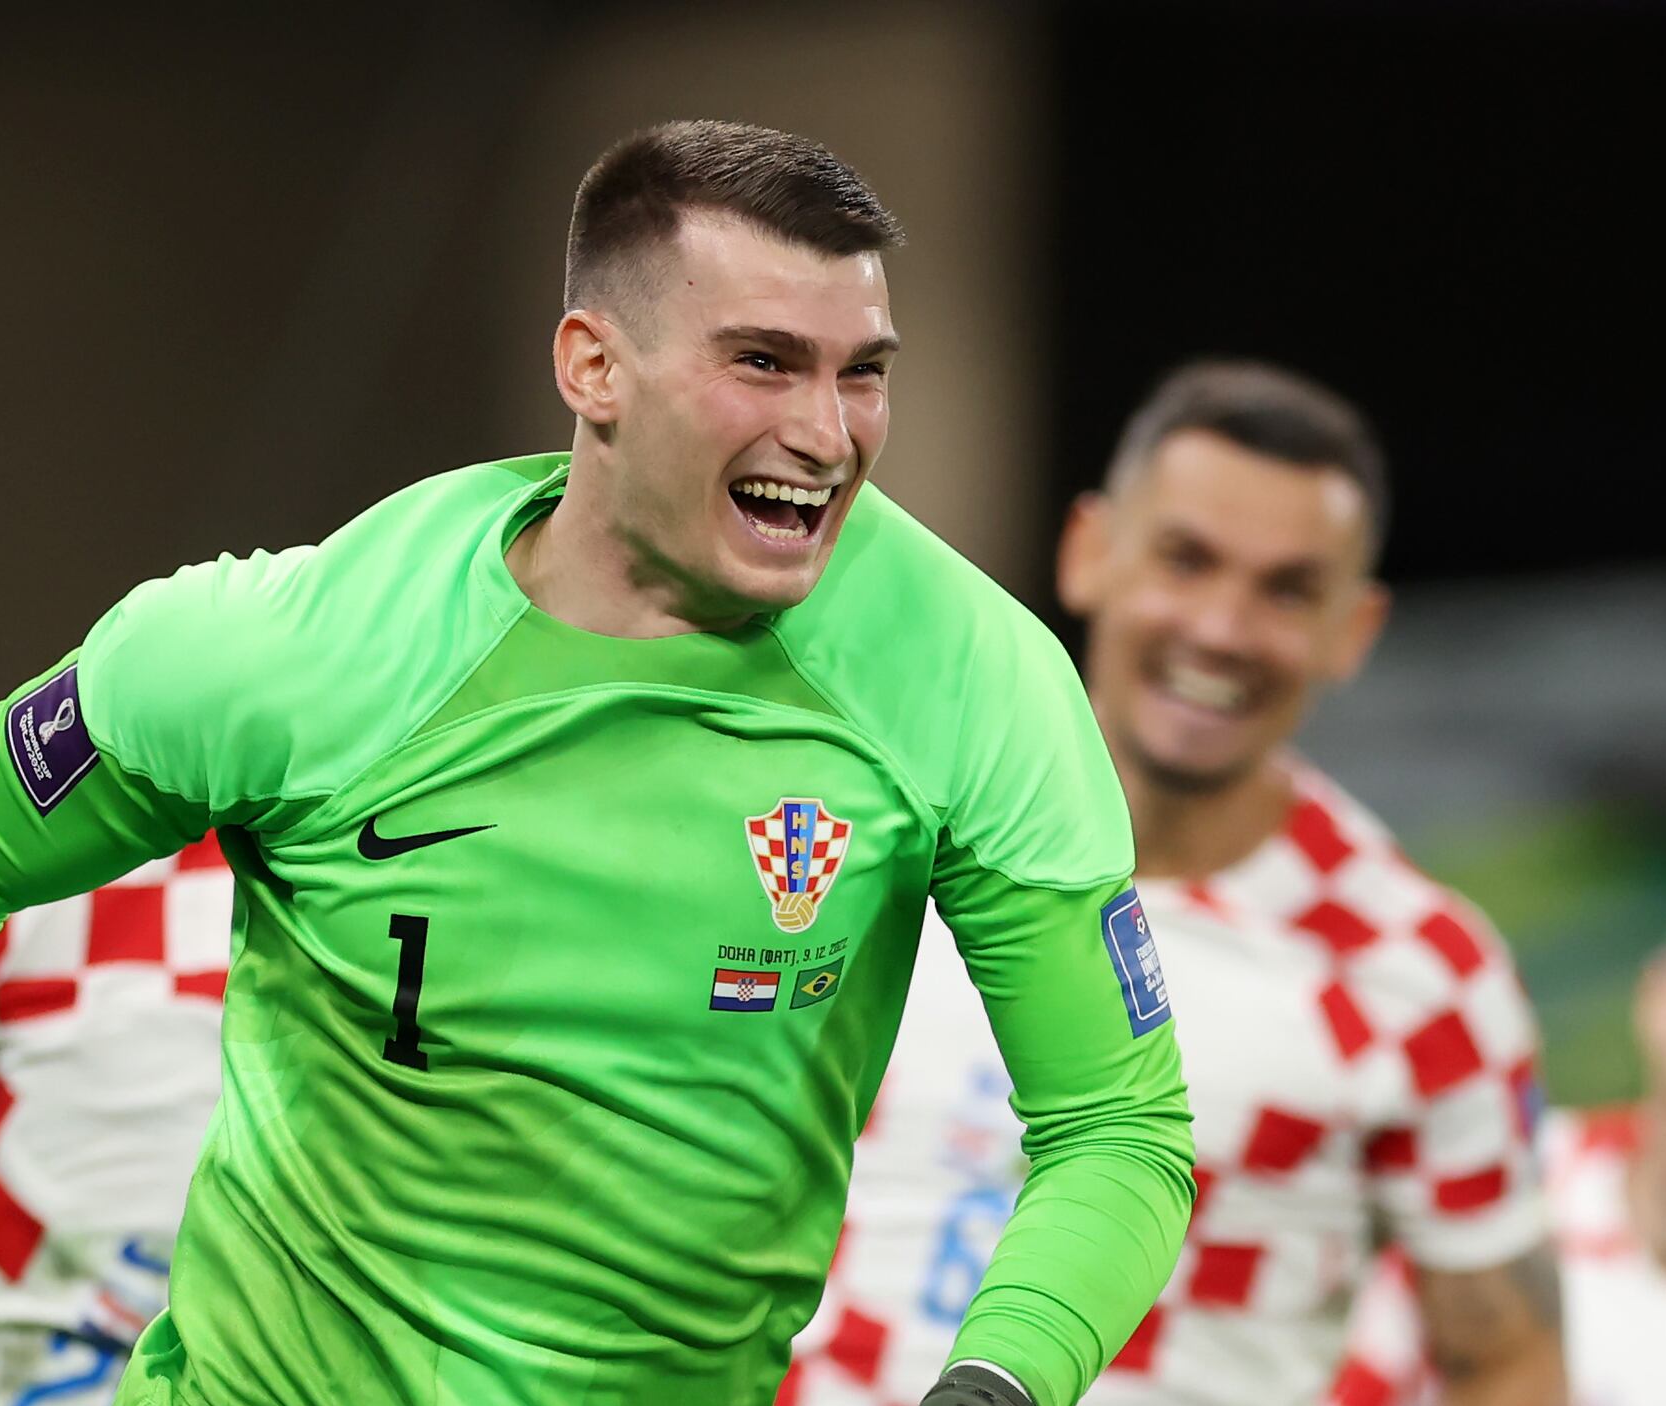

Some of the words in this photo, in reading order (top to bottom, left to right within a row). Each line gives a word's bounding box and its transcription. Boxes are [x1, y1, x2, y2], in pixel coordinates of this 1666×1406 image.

[29, 726, 43, 761] WORLD
[40, 760, 53, 779] CUP
[790, 811, 808, 880] HNS
[717, 944, 756, 962] DOHA
[382, 913, 430, 1072] 1
